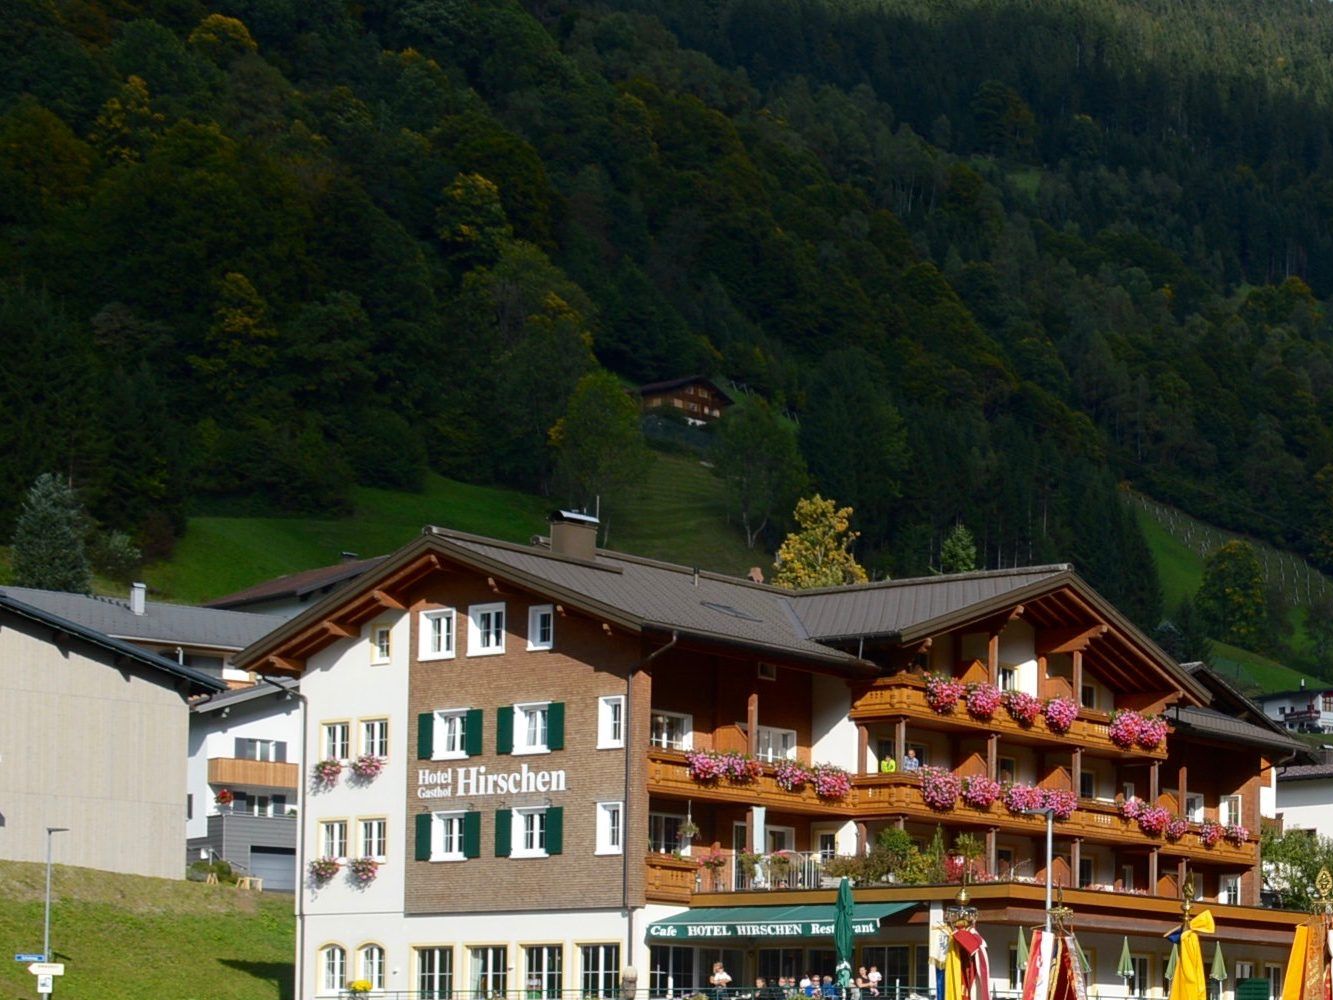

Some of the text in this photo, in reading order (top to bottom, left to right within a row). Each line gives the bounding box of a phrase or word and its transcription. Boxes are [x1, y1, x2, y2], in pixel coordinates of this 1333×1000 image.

[418, 768, 452, 785] Hotel
[456, 763, 567, 797] Hirschen
[417, 786, 452, 799] Gasthof
[650, 922, 875, 937] Cafe HOTEL HIRSCHEN Restant
